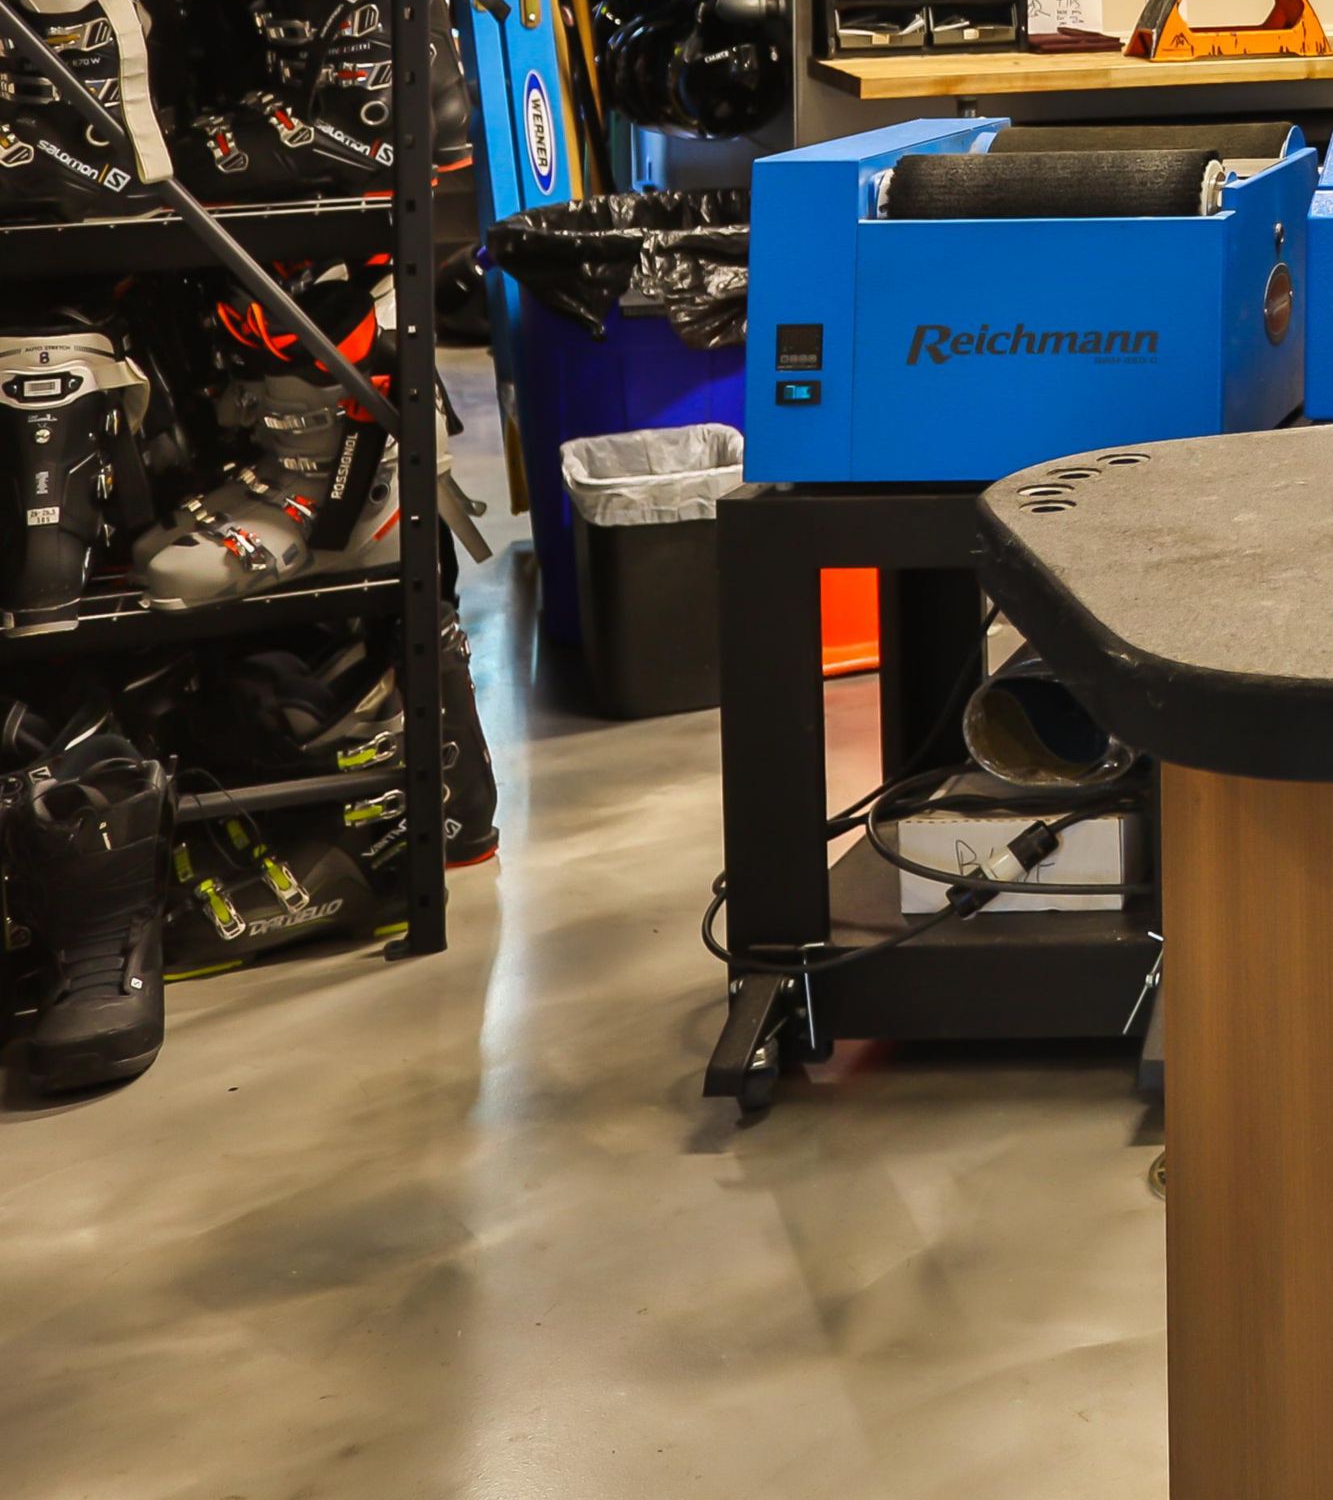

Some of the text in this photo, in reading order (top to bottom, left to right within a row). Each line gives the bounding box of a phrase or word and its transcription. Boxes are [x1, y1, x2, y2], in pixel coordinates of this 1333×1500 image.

[531, 98, 548, 167] WERNER
[906, 324, 1159, 366] Reichmann
[331, 432, 359, 500] ROSSIGNOL
